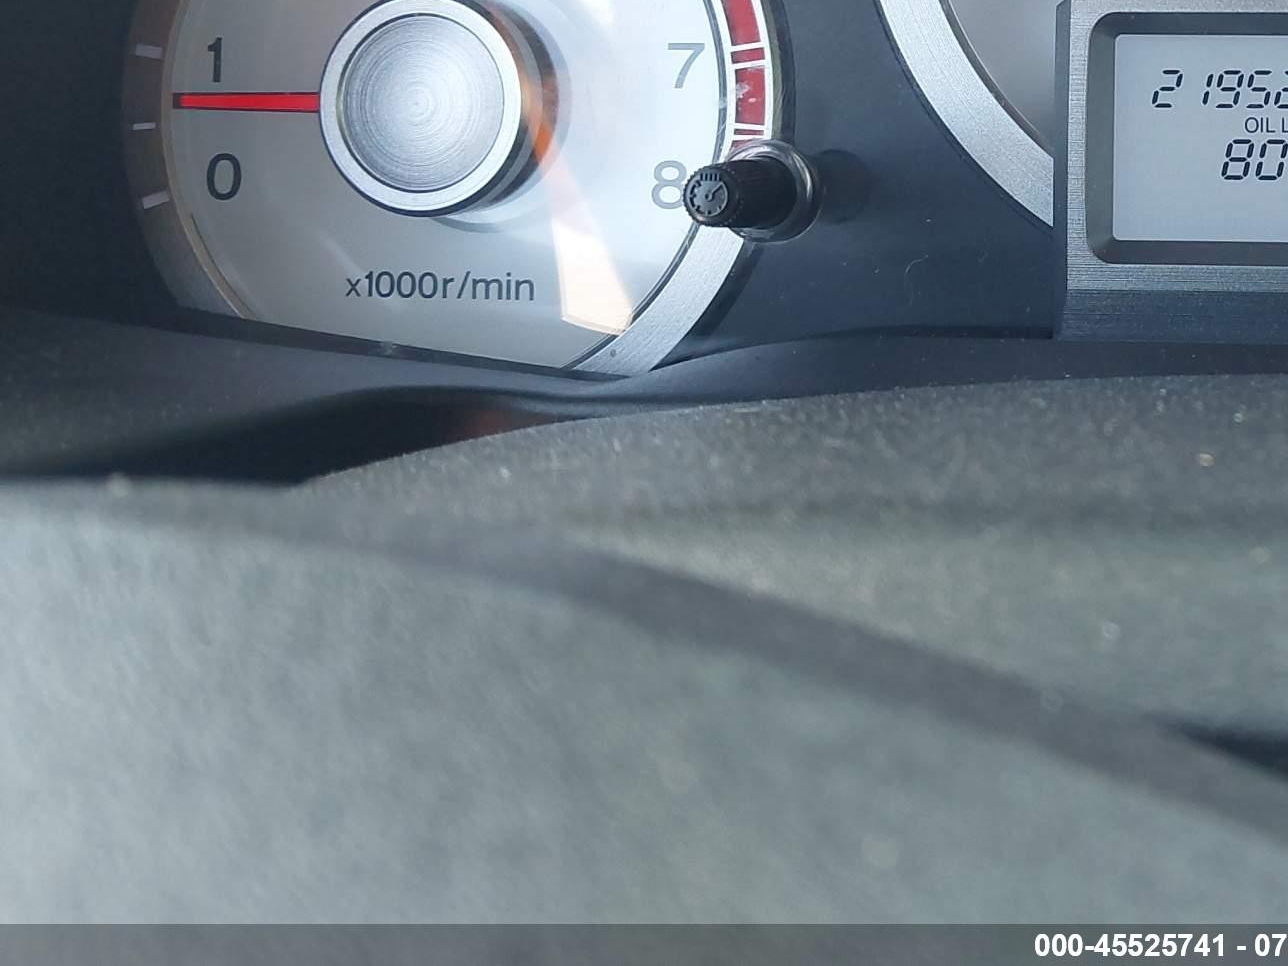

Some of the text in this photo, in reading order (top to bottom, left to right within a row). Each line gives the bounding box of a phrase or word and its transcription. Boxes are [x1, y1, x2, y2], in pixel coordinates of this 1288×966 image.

[207, 37, 224, 83] 1
[667, 42, 705, 88] 7
[1244, 117, 1276, 134] OIL
[206, 153, 242, 200] 0
[1221, 138, 1288, 181] 80
[651, 160, 687, 209] 8
[345, 269, 535, 302] x1000r/min
